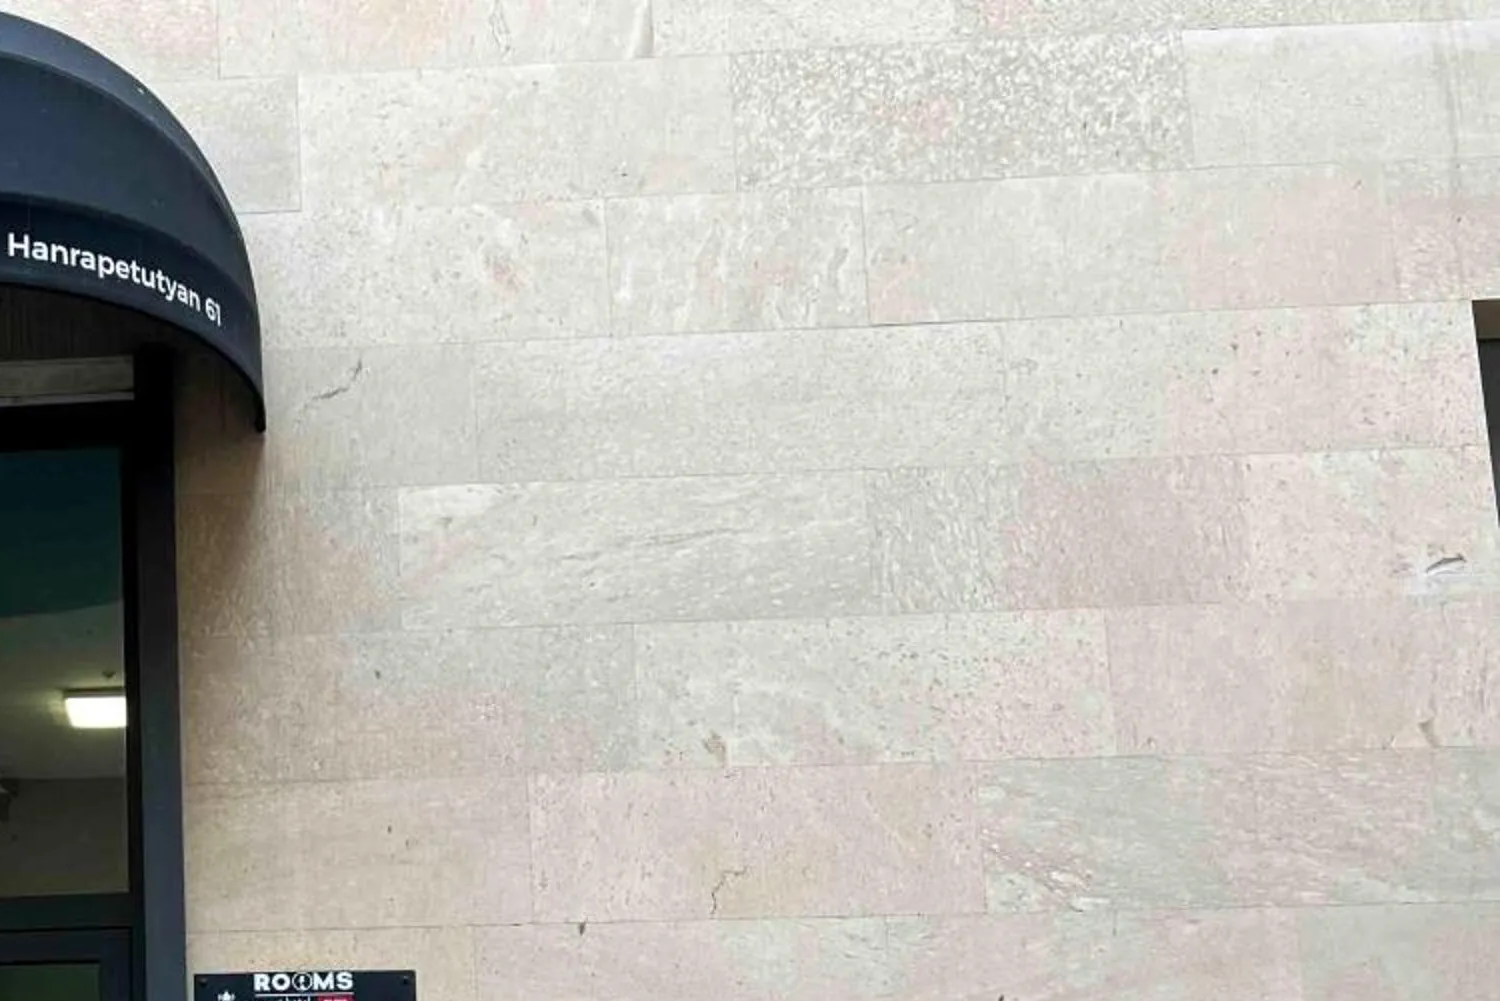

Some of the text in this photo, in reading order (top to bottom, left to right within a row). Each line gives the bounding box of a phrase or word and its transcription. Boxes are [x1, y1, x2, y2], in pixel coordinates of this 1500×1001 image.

[7, 232, 222, 326] Hanrapetutyan 61
[253, 972, 354, 991] ROOMS
